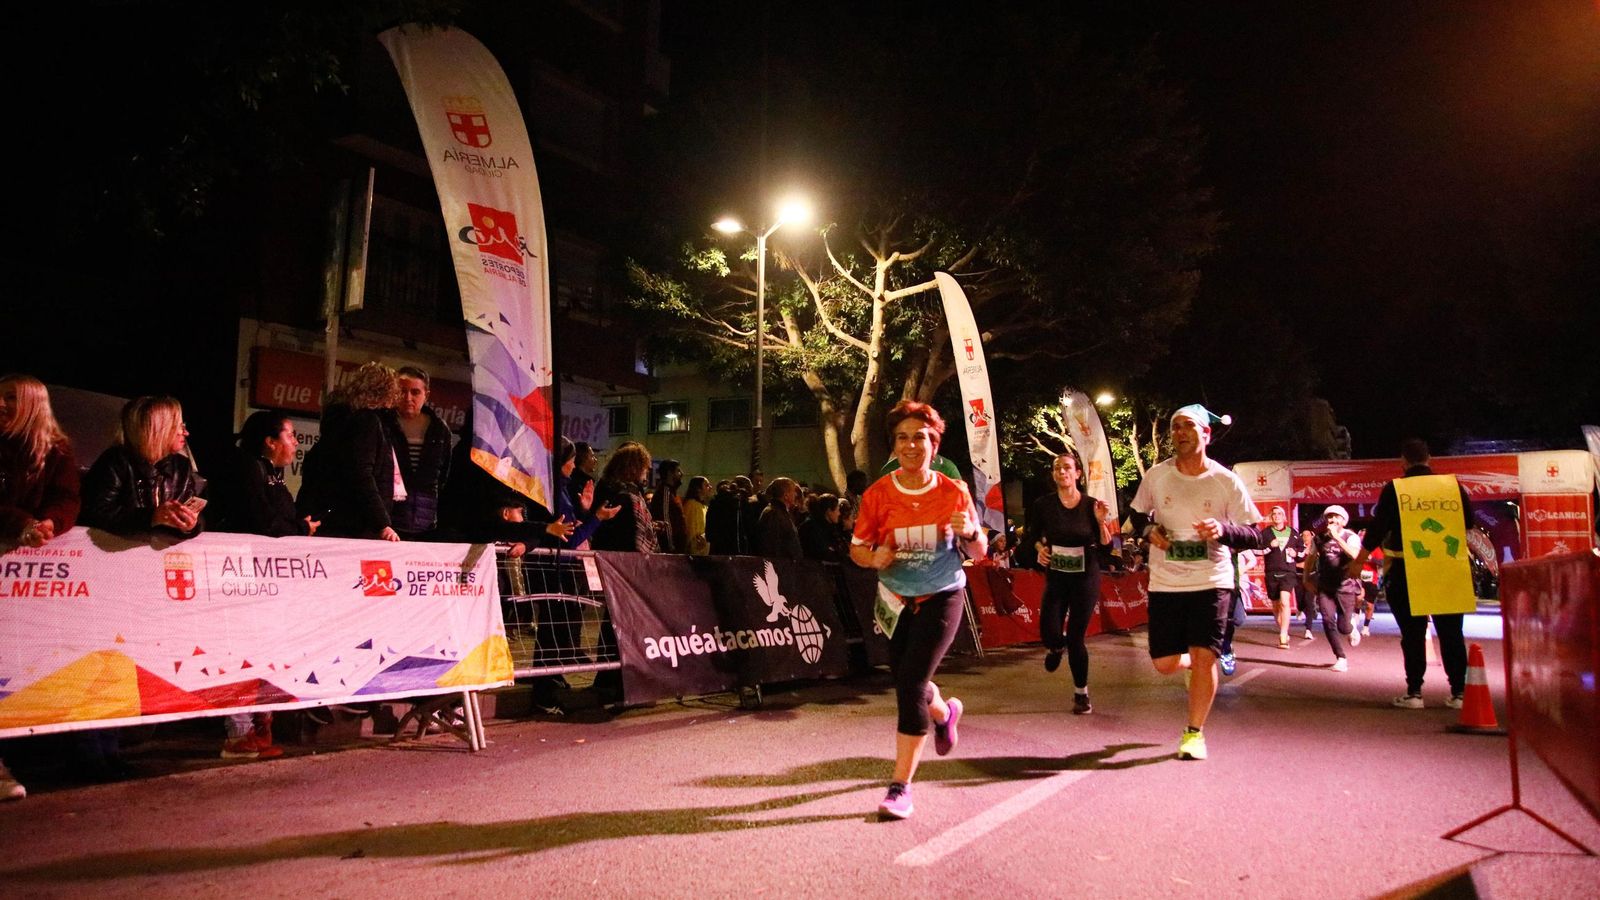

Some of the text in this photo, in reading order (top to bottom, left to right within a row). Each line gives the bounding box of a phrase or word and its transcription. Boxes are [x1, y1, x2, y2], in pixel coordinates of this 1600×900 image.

[272, 383, 313, 408] que
[1168, 545, 1205, 559] 1339
[0, 561, 70, 579] RTES
[221, 553, 328, 579] ALMERÍA
[407, 570, 476, 584] DEPORTES
[221, 582, 279, 597] CIUDAD
[409, 584, 485, 597] DE ALMERIA
[643, 625, 794, 668] aquéatacamos
